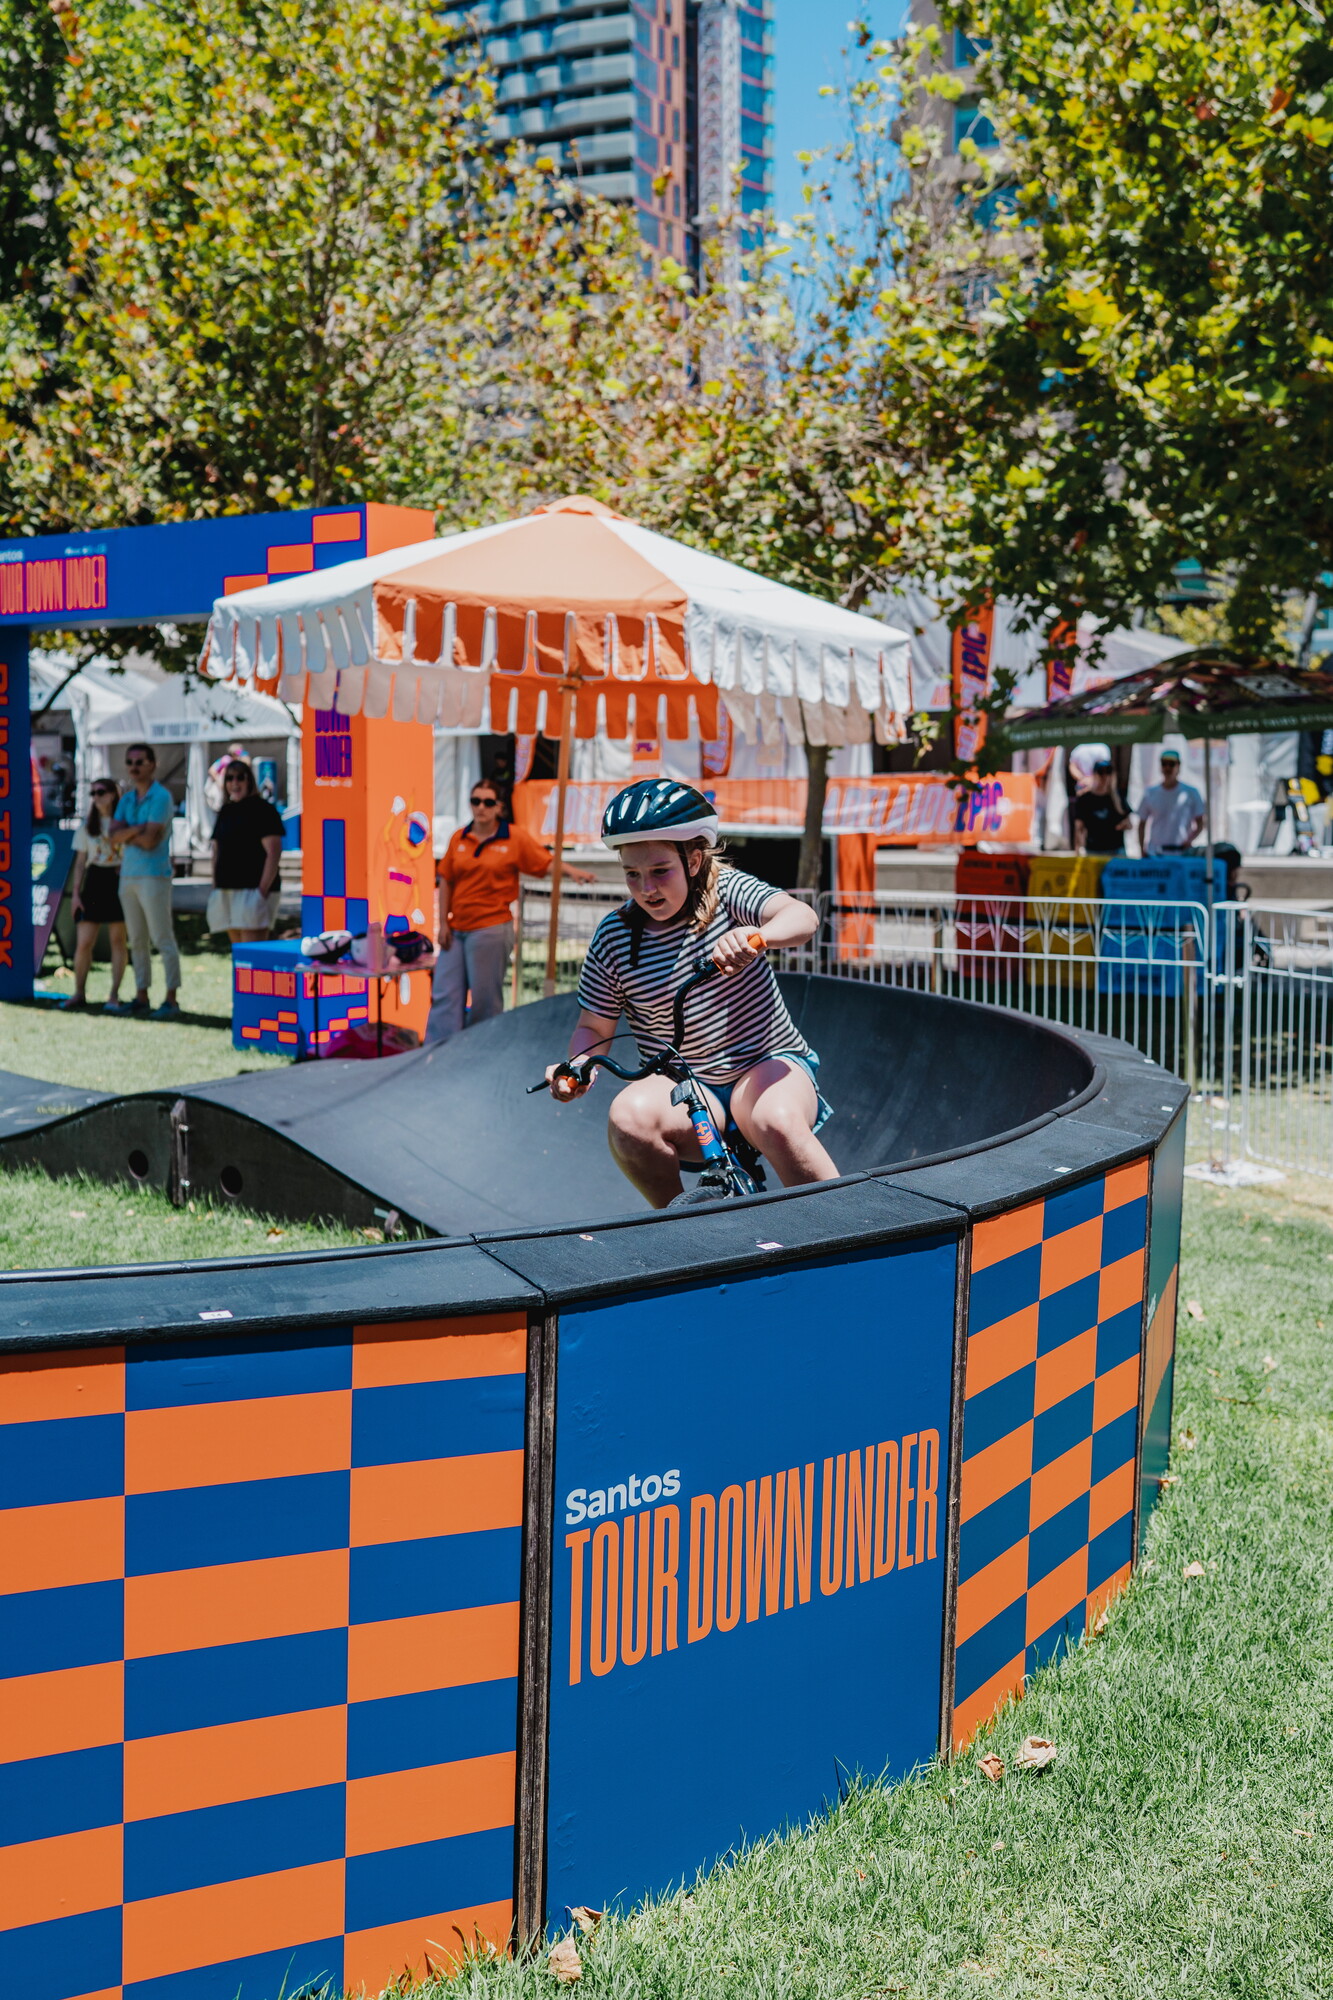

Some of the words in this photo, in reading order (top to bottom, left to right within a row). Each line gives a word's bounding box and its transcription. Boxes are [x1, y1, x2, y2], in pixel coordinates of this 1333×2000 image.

[0, 562, 24, 615] OUR
[26, 559, 64, 613] DOWN
[65, 554, 107, 611] UNDER
[960, 626, 988, 682] EPIC
[315, 734, 352, 778] UNDER
[822, 783, 957, 835] ADELAIDE
[564, 1468, 681, 1525] Santos
[565, 1503, 681, 1686] TOUR
[687, 1461, 815, 1645] DOWN
[819, 1427, 940, 1597] UNDER
